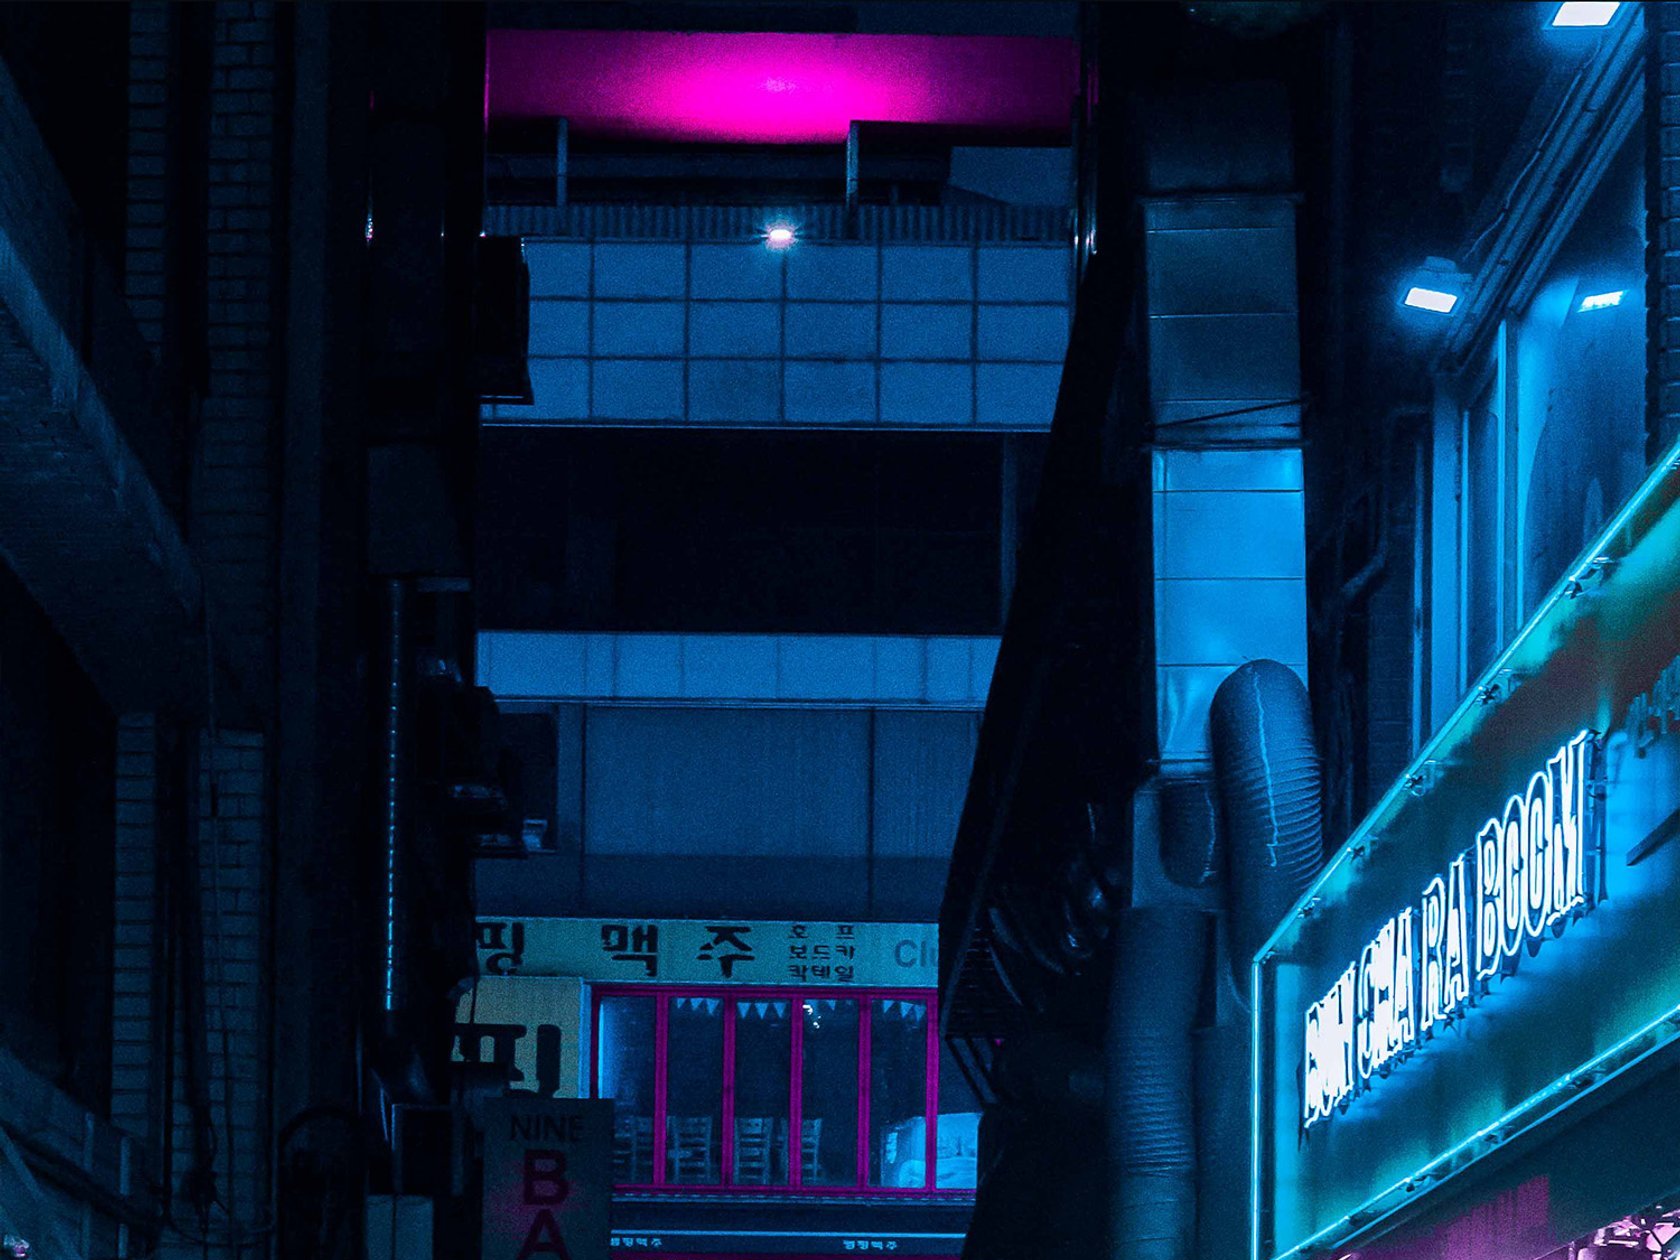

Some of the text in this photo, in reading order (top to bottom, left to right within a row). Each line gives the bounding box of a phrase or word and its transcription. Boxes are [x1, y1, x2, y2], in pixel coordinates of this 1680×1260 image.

[1475, 730, 1590, 980] BOOM
[602, 924, 755, 978] 맥주
[788, 945, 855, 960] 보드카
[788, 965, 855, 982] 칵테일
[510, 1114, 584, 1142] NINE
